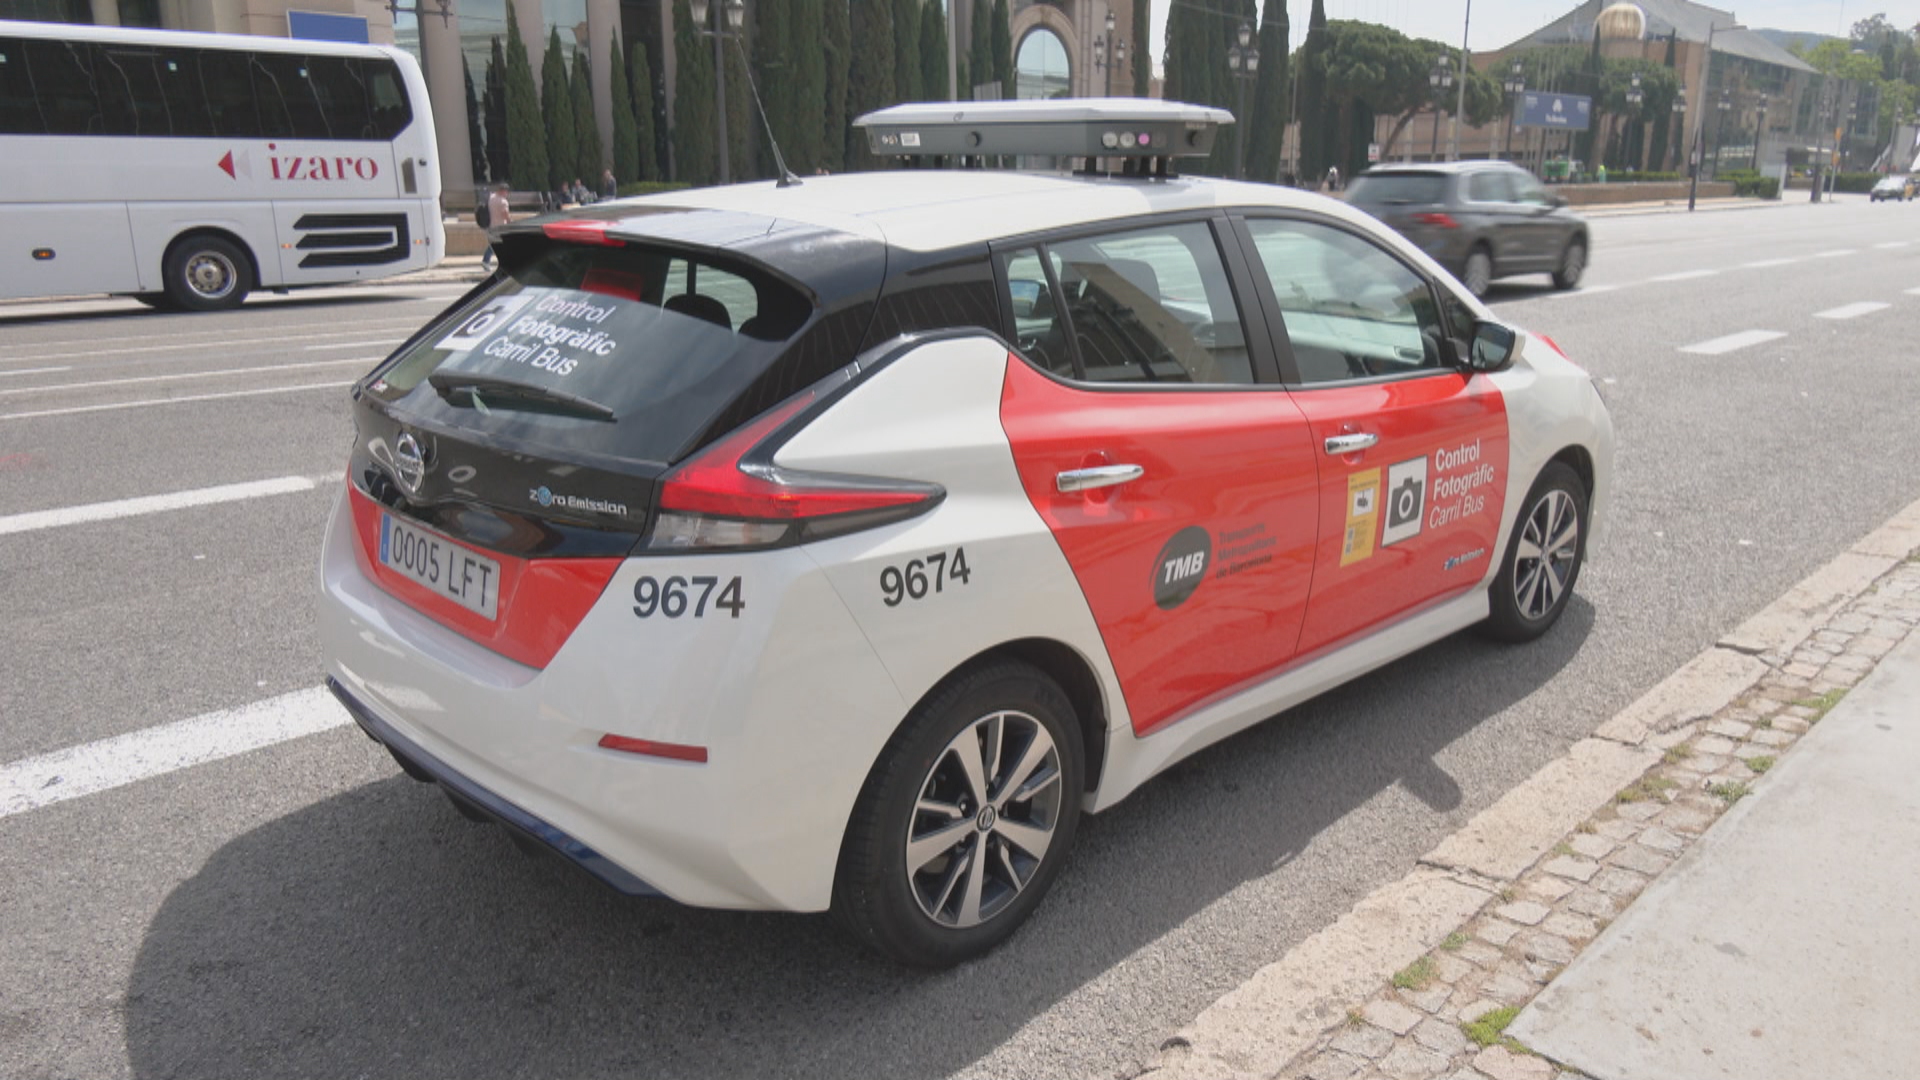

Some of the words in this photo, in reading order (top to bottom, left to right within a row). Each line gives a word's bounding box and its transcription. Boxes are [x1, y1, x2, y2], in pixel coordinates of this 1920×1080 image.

[268, 143, 379, 181] izaro
[536, 295, 616, 324] Control
[508, 315, 617, 356] Fotogràfic
[531, 348, 578, 375] Bus
[1435, 438, 1480, 472] Control
[1433, 464, 1494, 501] Fotogràfic
[1429, 499, 1459, 529] Carril
[1462, 495, 1485, 517] Bus
[393, 526, 439, 583] 0005
[448, 551, 492, 607] LFT
[880, 547, 971, 607] 9674
[1165, 550, 1205, 585] TMB
[633, 576, 745, 619] 9674
